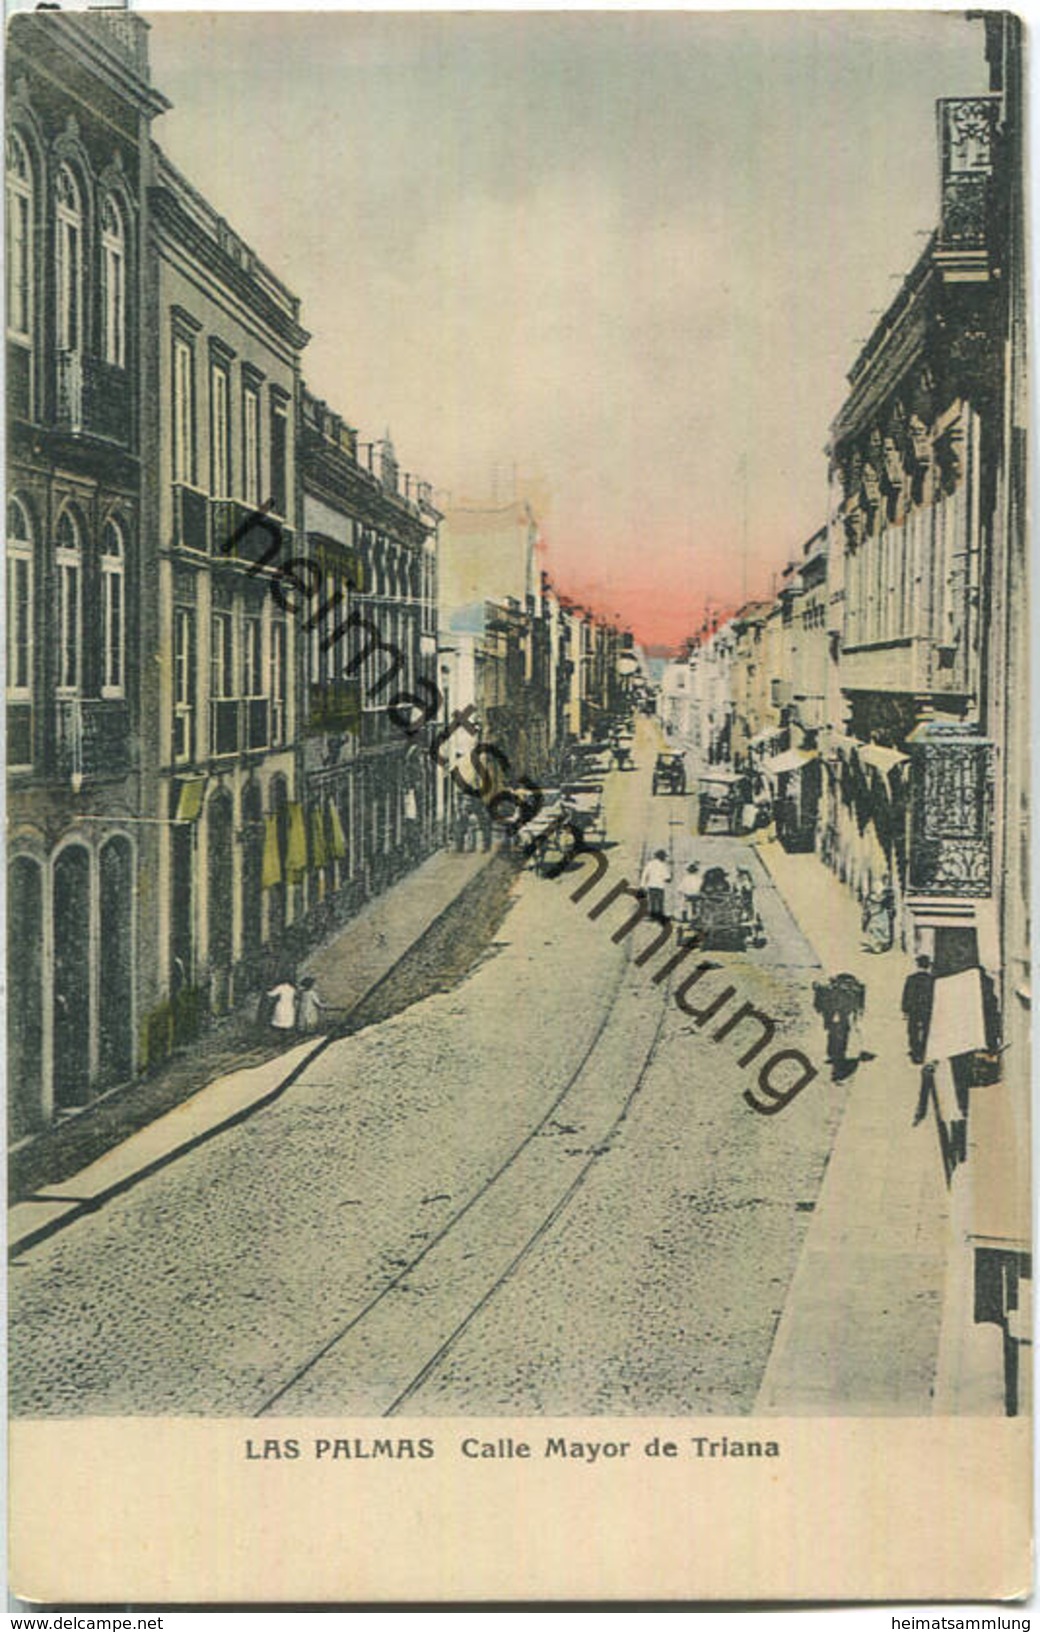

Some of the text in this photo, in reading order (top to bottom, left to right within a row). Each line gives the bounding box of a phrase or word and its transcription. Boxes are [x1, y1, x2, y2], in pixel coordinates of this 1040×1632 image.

[246, 1436, 780, 1463] LAS PALMAS Calle Mayor de Triana
